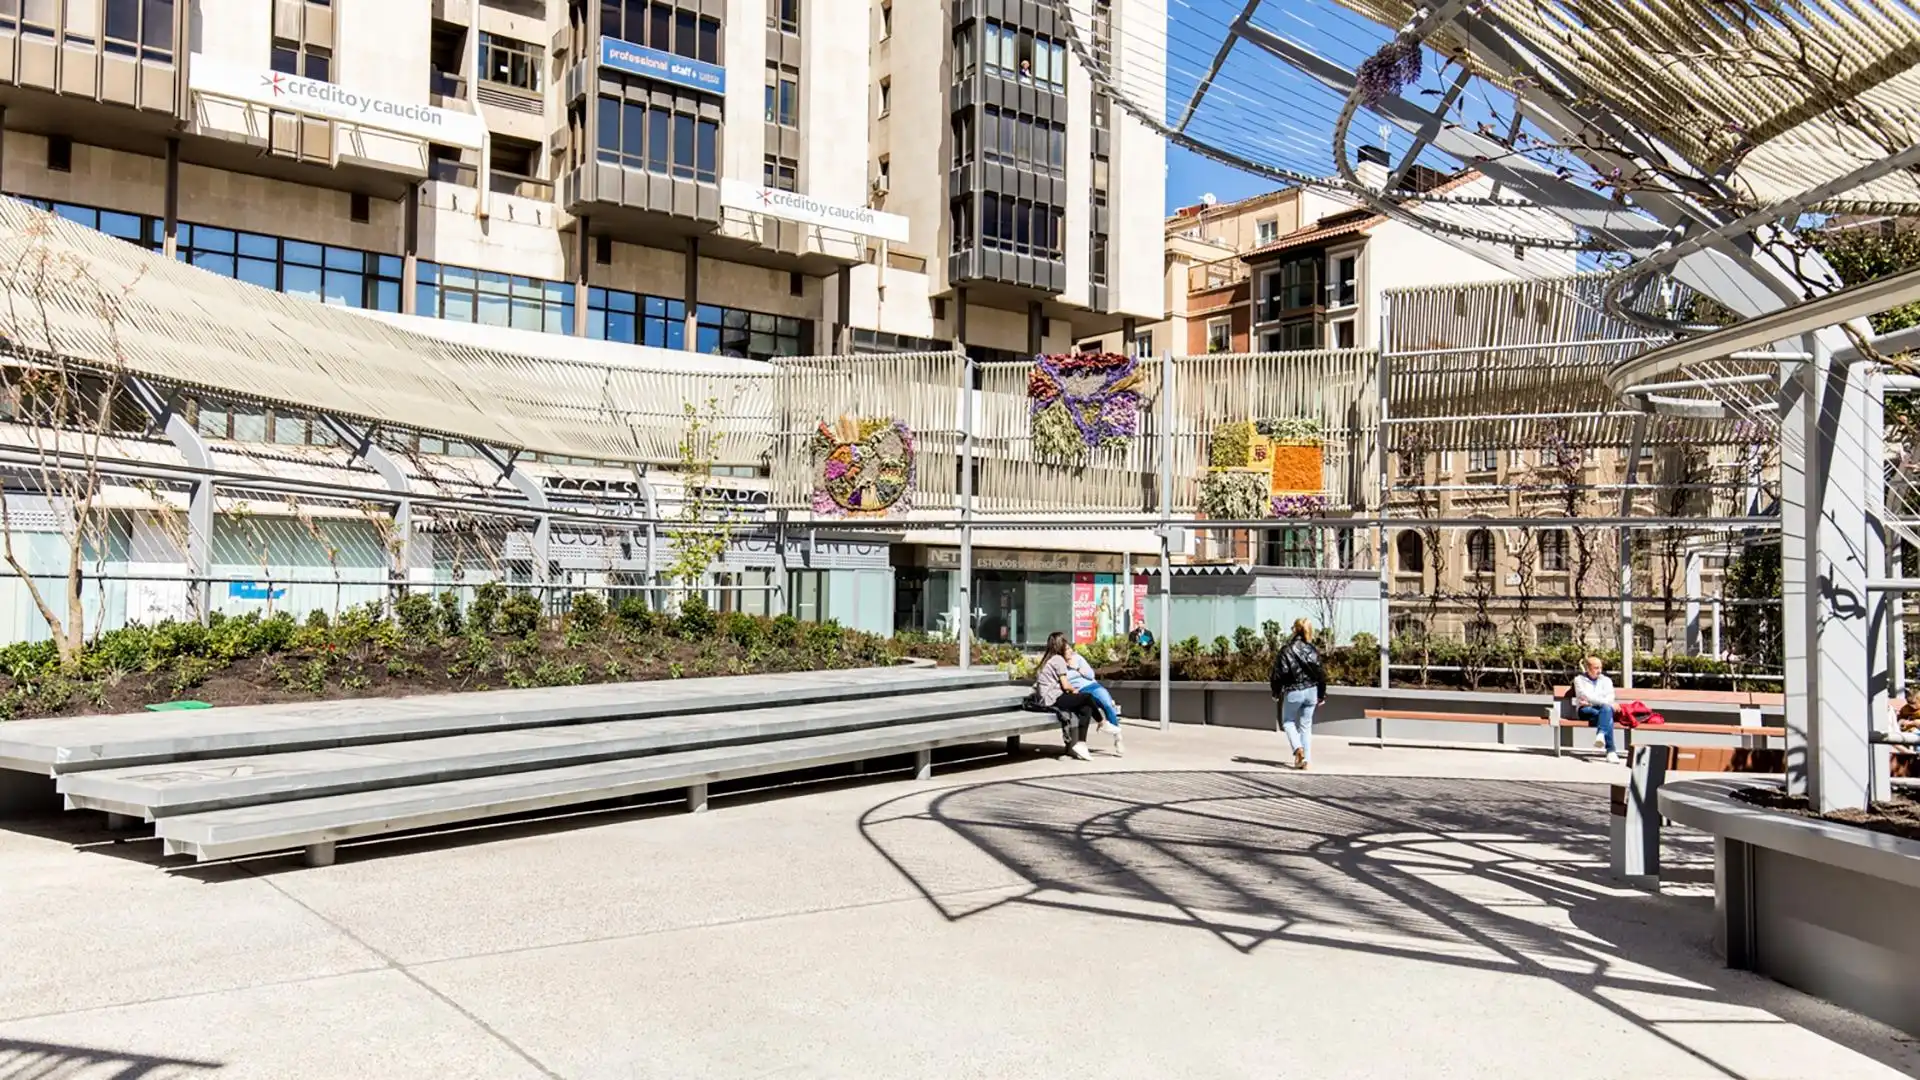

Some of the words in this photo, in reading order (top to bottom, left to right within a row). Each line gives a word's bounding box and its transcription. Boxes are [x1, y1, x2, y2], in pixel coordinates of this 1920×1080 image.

[609, 48, 668, 71] professional
[288, 79, 357, 107] crédito
[360, 96, 371, 112] y
[373, 100, 442, 126] caución
[773, 193, 819, 211] crédito
[819, 204, 827, 217] y
[828, 206, 875, 224] caución
